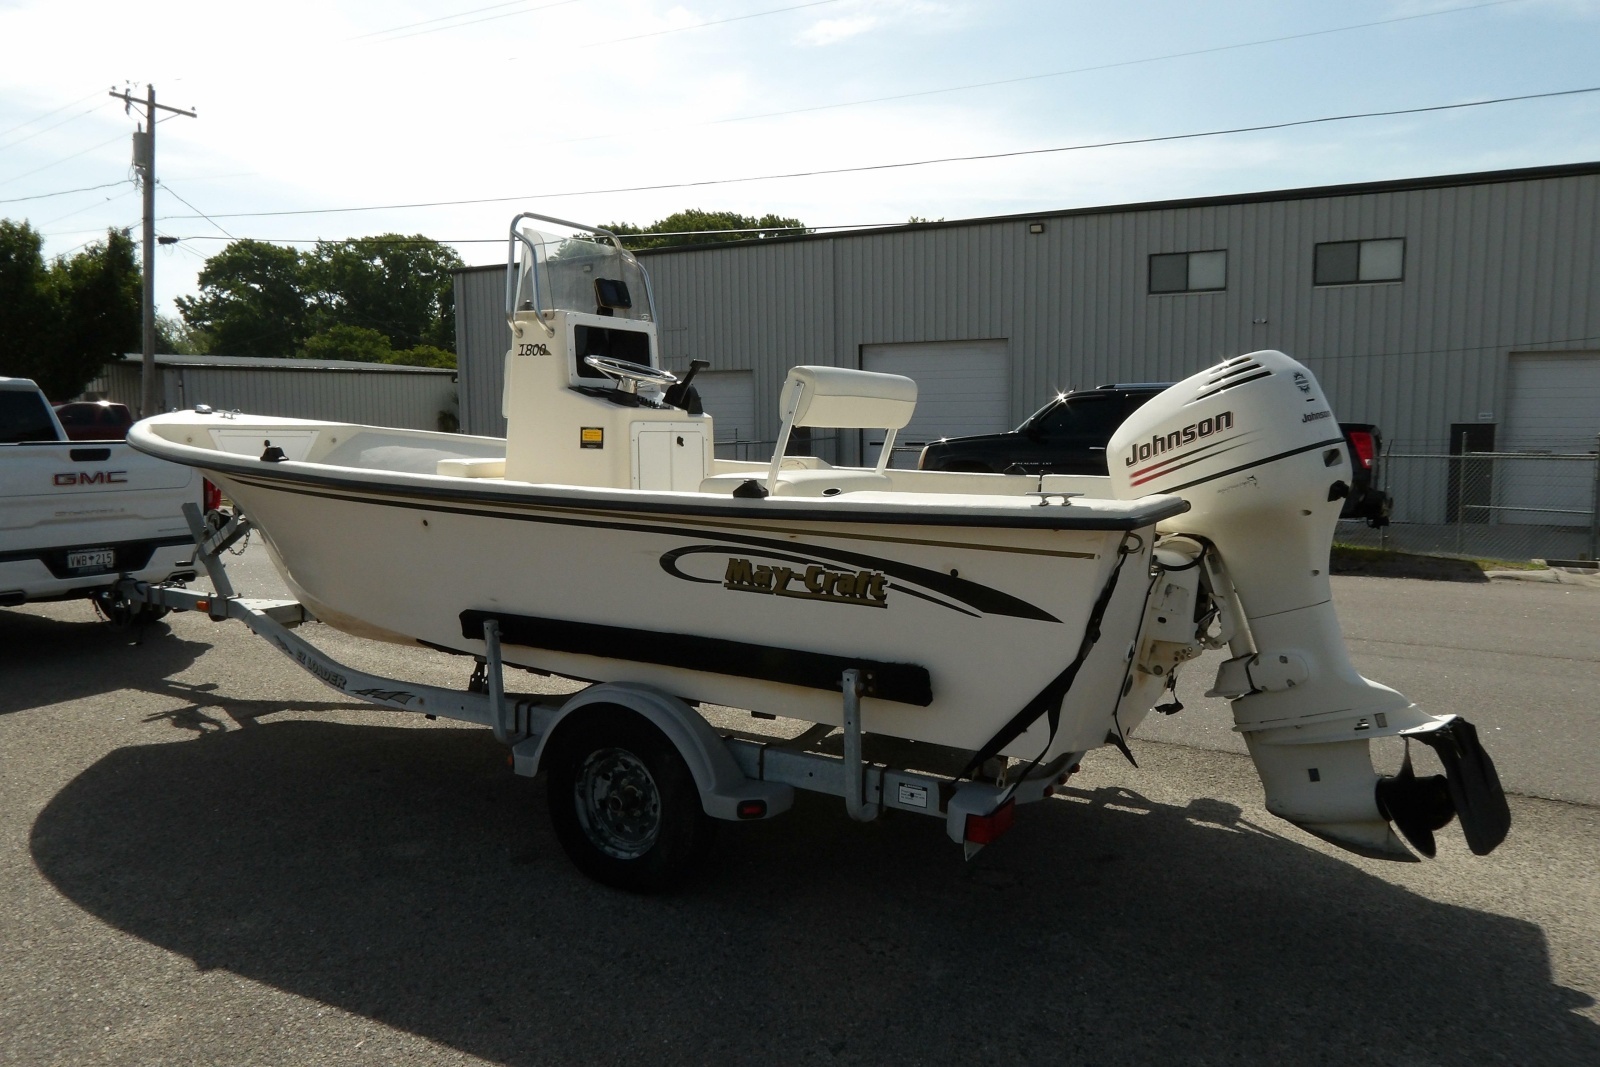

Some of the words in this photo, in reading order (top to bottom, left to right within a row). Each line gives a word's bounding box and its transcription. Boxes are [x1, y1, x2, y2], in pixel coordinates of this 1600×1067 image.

[518, 343, 546, 357] 1800
[1302, 410, 1332, 423] Johnson
[1126, 411, 1234, 467] Johnson
[54, 471, 128, 486] GMC
[70, 555, 87, 567] VWB
[95, 553, 112, 565] 215
[725, 557, 888, 601] May-Craft
[307, 656, 347, 690] LOADER
